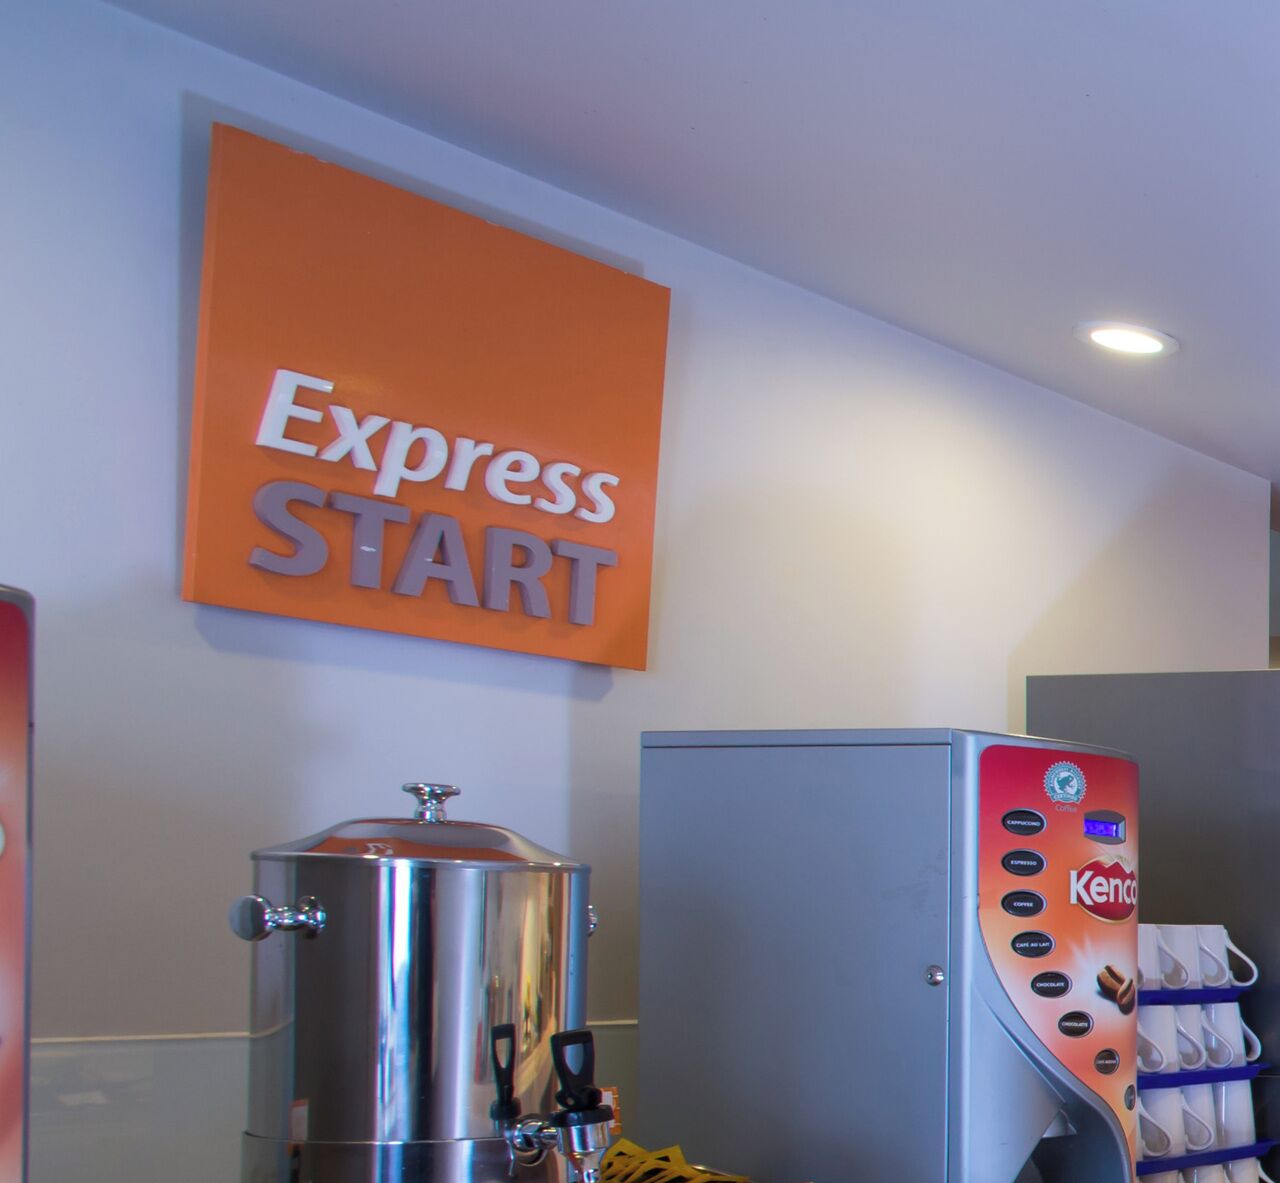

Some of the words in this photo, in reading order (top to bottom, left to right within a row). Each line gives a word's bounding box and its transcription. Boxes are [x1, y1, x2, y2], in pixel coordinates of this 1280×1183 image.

[256, 369, 620, 524] Express
[247, 480, 618, 626] START
[1069, 869, 1136, 906] Kenco
